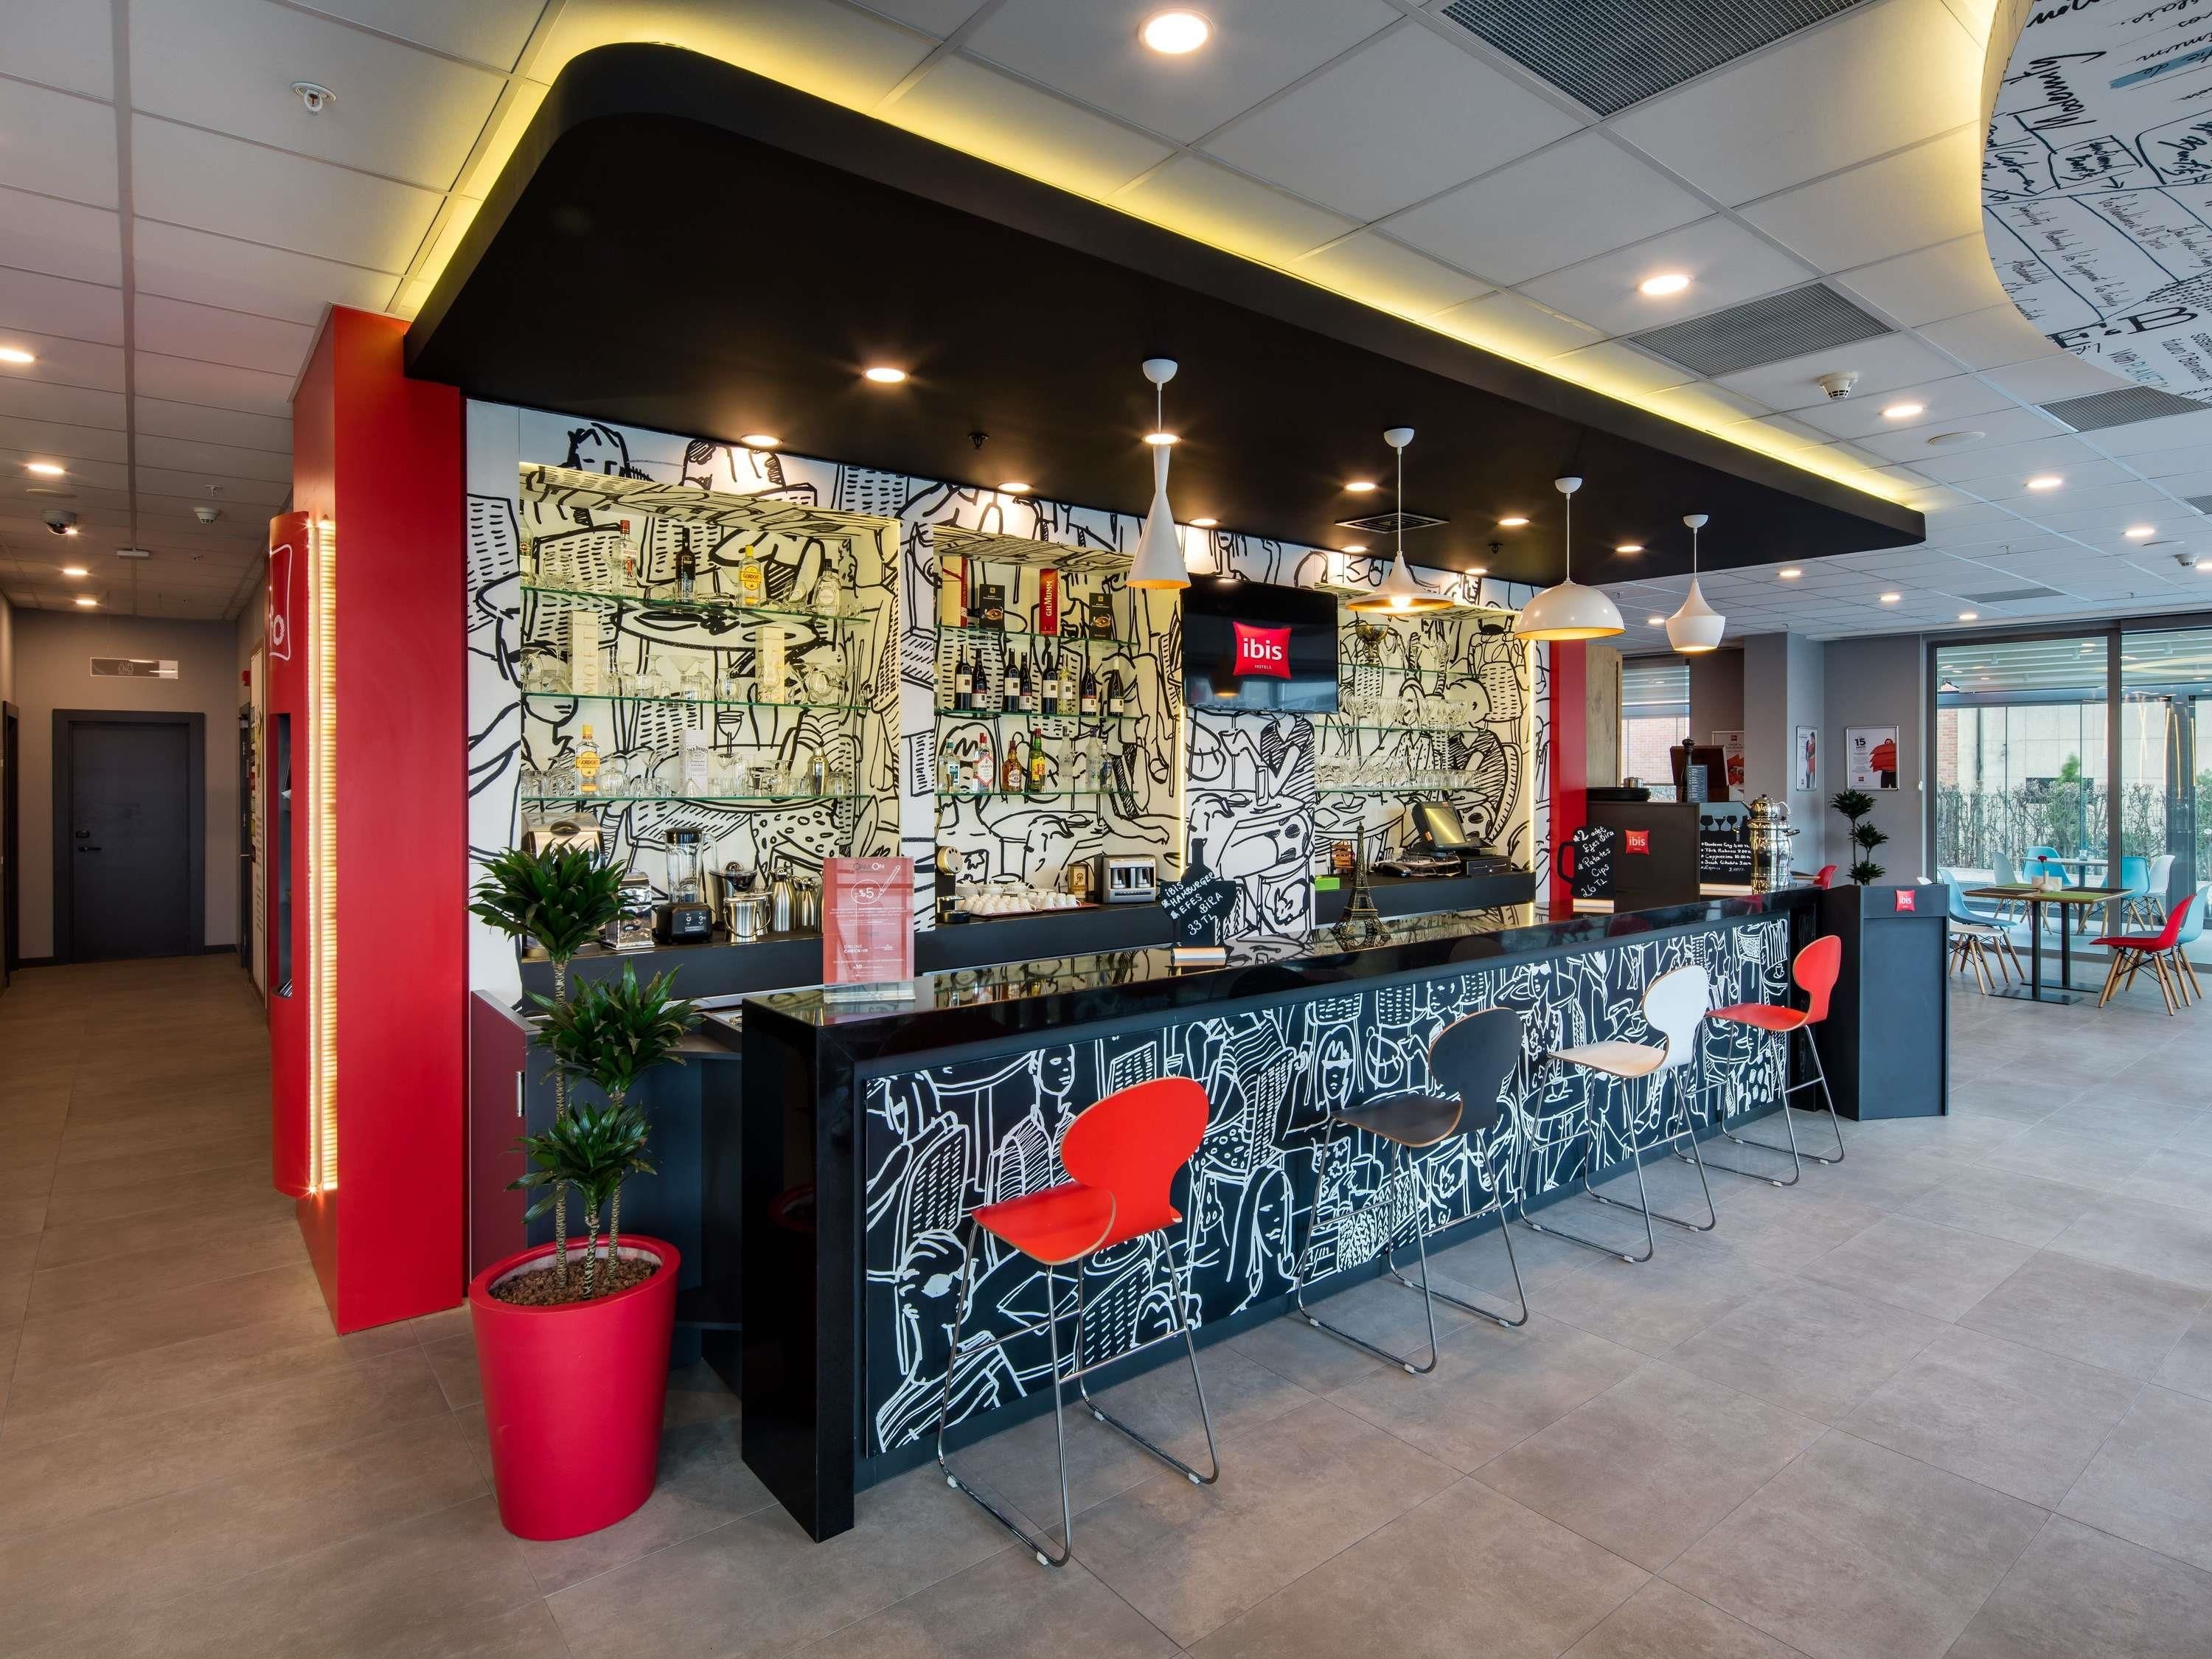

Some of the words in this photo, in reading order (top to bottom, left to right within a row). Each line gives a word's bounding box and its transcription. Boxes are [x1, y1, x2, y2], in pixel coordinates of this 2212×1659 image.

[1243, 638, 1282, 661] ibis
[1854, 738, 1866, 746] 15
[1630, 836, 1645, 846] ibis
[1581, 884, 1596, 897] 26
[1179, 893, 1203, 914] EFES
[1899, 895, 1912, 905] ibis
[1187, 920, 1203, 936] 33
